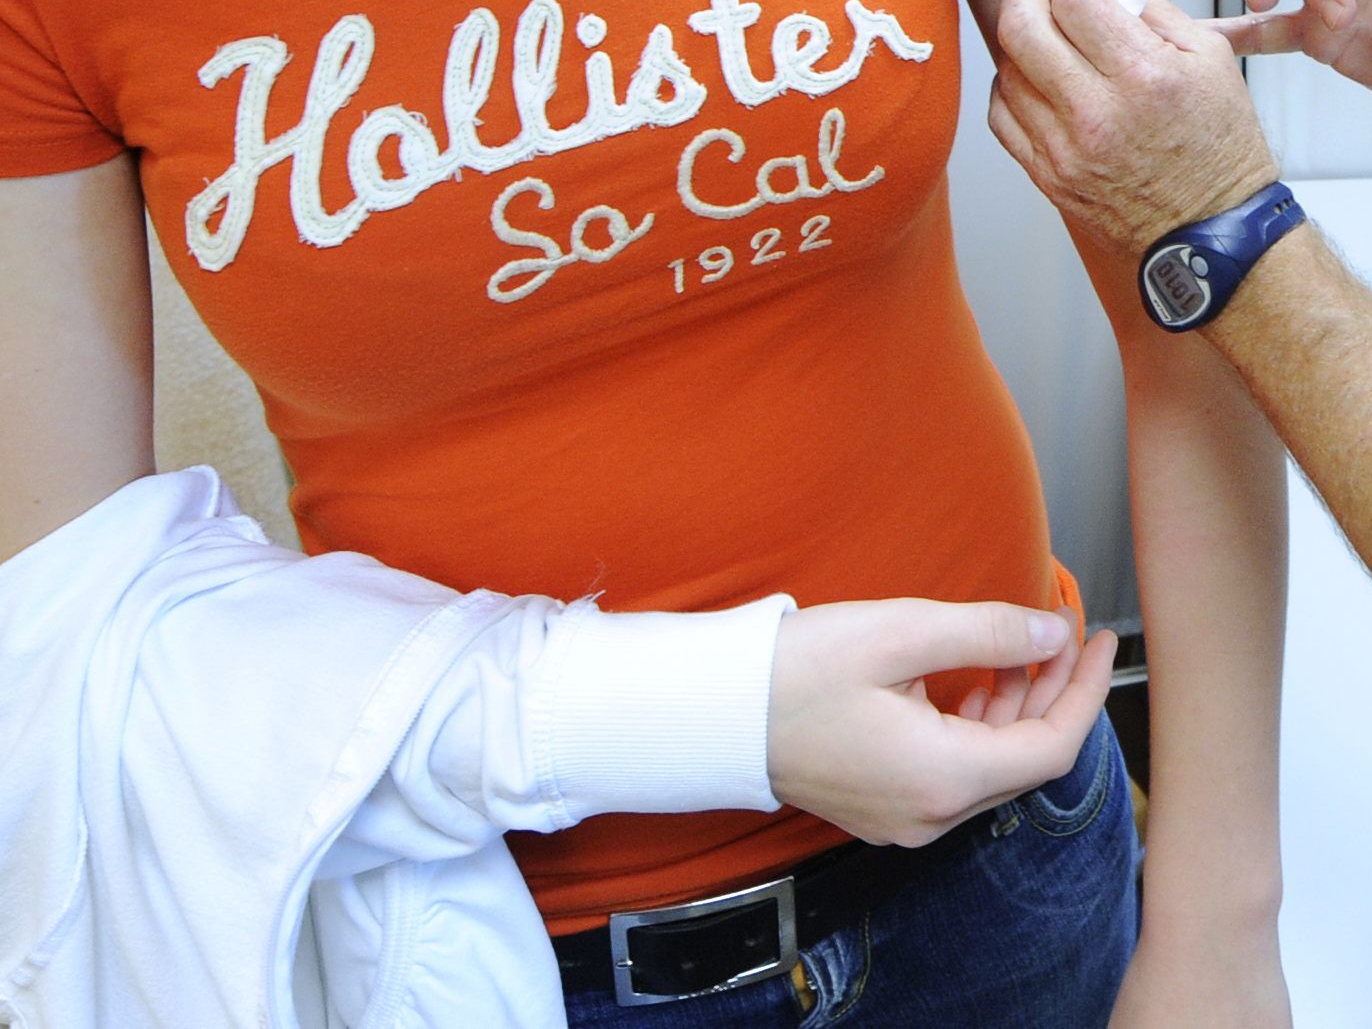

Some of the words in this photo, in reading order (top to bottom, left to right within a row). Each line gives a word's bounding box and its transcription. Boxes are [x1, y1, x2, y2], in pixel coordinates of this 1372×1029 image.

[487, 177, 655, 303] So
[677, 107, 885, 220] Cal
[667, 215, 832, 294] 1922
